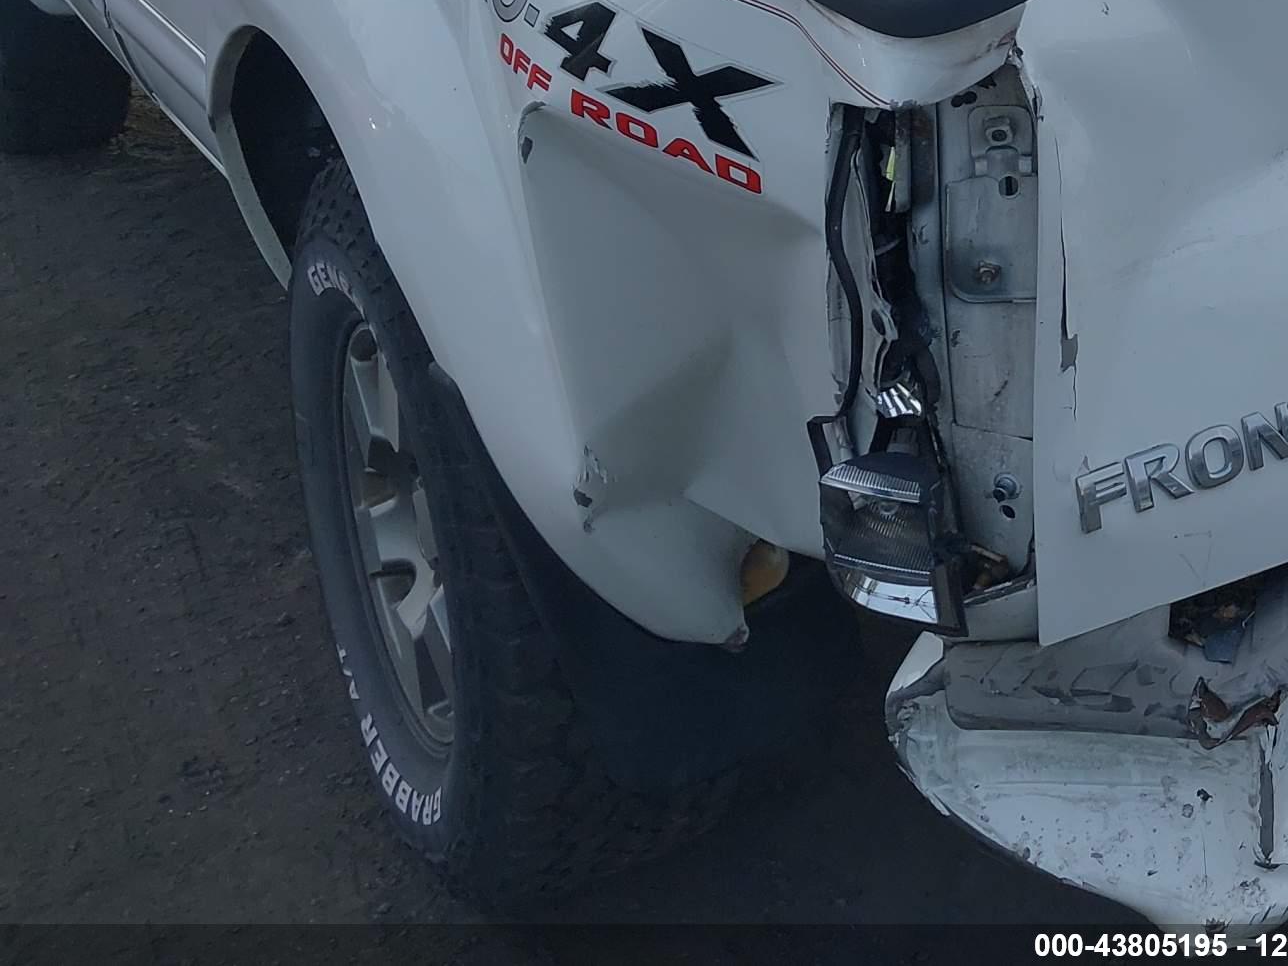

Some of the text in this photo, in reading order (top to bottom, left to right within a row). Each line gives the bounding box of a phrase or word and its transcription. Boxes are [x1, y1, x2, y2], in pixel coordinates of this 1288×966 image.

[500, 33, 762, 195] OFF ROAD
[361, 712, 442, 825] GRABBER
